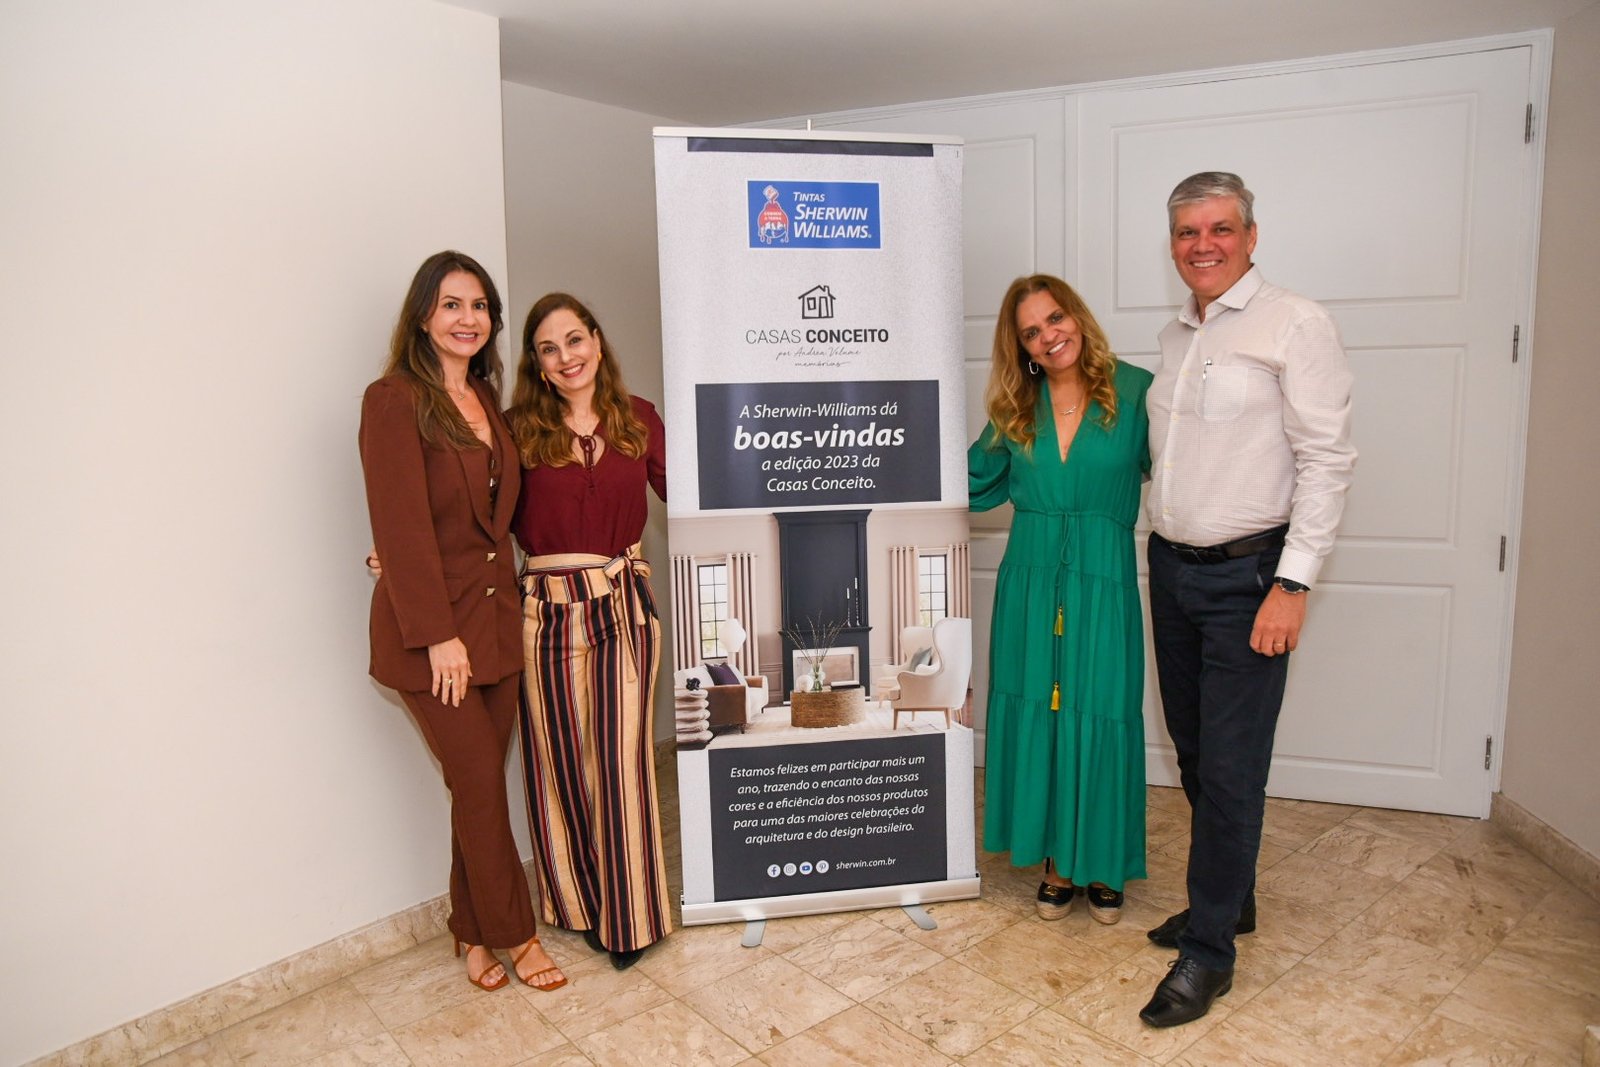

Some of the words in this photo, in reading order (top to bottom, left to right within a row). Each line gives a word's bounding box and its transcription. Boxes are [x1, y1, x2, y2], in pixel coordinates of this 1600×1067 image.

[793, 192, 825, 202] TINTAS
[795, 204, 868, 221] SHERWIN
[745, 329, 801, 344] CASAS
[805, 328, 889, 344] CONCEITO
[739, 404, 750, 418] A
[753, 403, 877, 418] Sherwin-Williams
[880, 401, 898, 415] dá
[734, 422, 905, 450] boas-vindas
[762, 459, 771, 471] a
[774, 456, 821, 472] edição
[824, 455, 858, 469] 2023
[862, 454, 880, 468] da
[767, 478, 808, 492] Casas
[811, 476, 876, 490] Conceito.
[730, 766, 775, 778] Estamos
[777, 763, 809, 775] felizes
[810, 763, 827, 773] em
[829, 758, 880, 774] participar
[882, 756, 906, 768] mais
[908, 755, 925, 765] um
[737, 785, 761, 795] ano,
[763, 780, 810, 793] trazendo
[812, 781, 819, 789] o
[821, 777, 863, 789] encanto
[865, 774, 883, 785] das
[885, 772, 919, 783] nossas
[728, 802, 756, 812] cores
[758, 801, 764, 810] e
[766, 801, 774, 810] a
[775, 794, 824, 809] eficiência
[826, 794, 845, 805] dos
[847, 792, 881, 803] nossos
[883, 787, 929, 802] produtos
[733, 818, 759, 830] para
[760, 817, 785, 827] uma
[786, 814, 805, 825] das
[807, 811, 849, 823] maiores
[850, 806, 909, 820] celebrações
[911, 804, 925, 815] da
[745, 832, 804, 845] arquitetura
[806, 831, 813, 840] e
[814, 829, 828, 840] do
[830, 825, 864, 839] design
[865, 821, 914, 835] brasileiro.
[835, 857, 896, 870] sherwin.com.br
